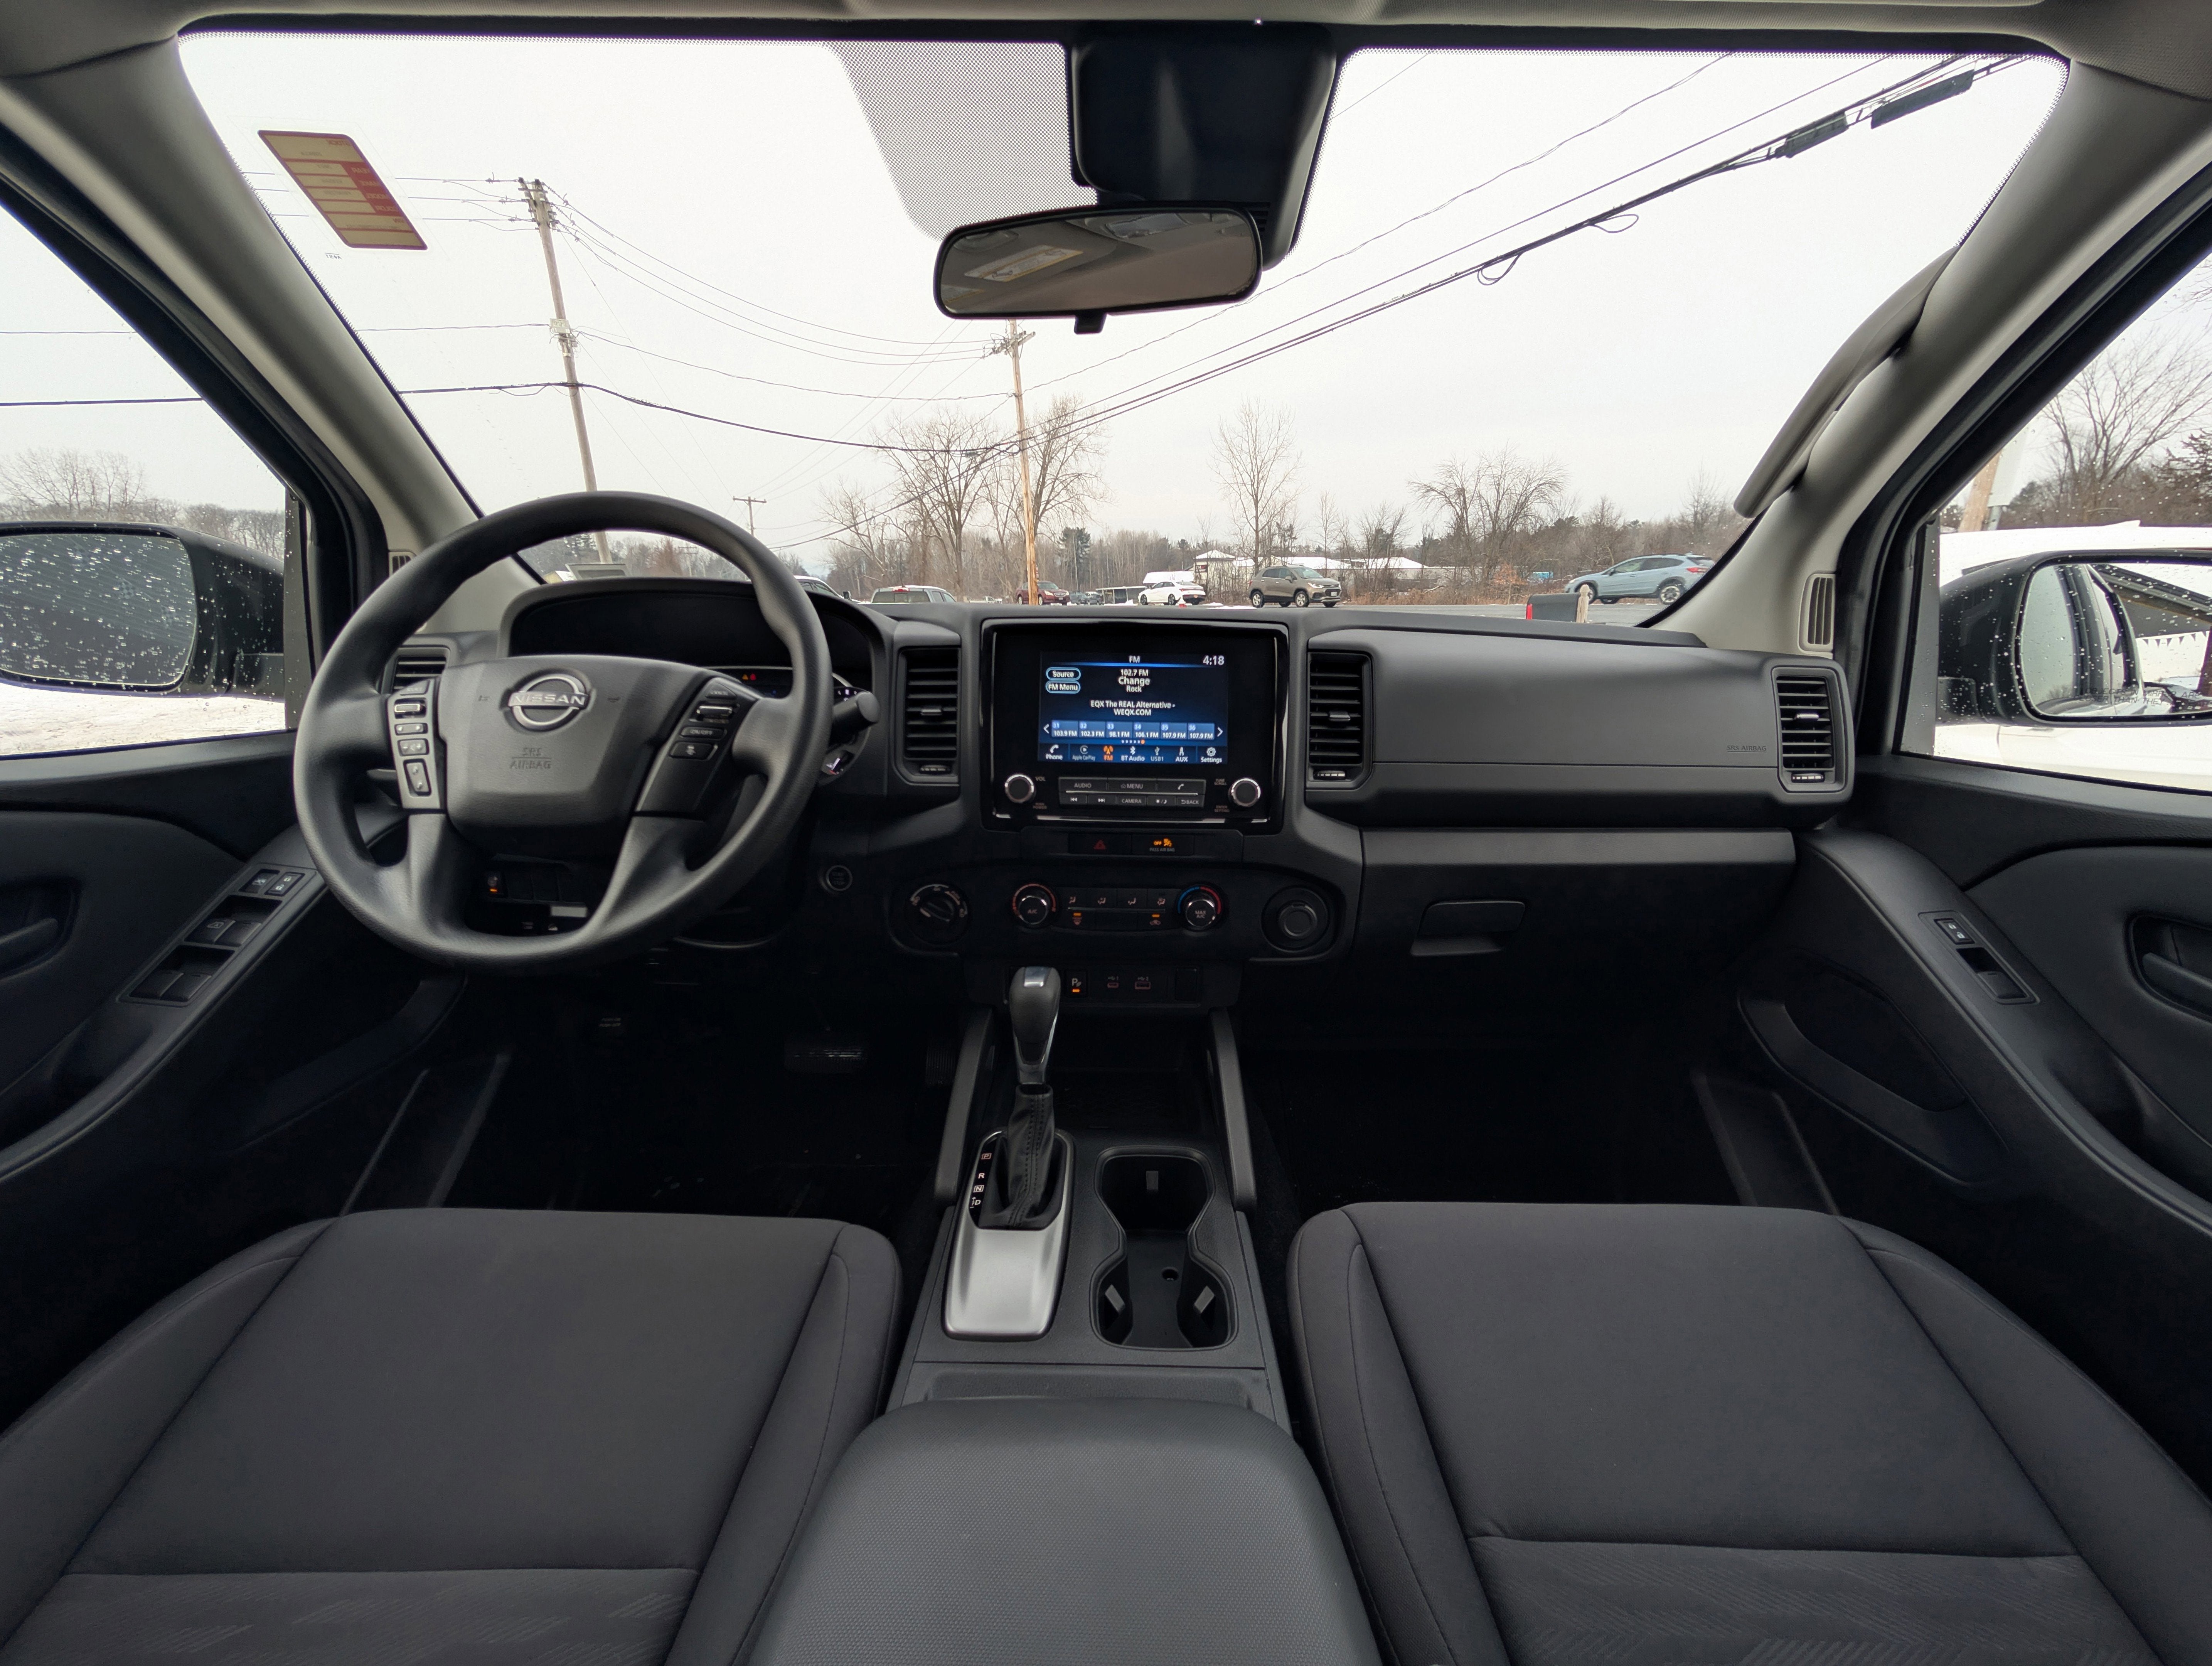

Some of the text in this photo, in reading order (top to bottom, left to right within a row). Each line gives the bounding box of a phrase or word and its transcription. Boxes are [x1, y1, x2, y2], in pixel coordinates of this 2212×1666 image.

[1203, 655, 1225, 665] 4:18
[1118, 676, 1150, 687] Change
[512, 694, 586, 706] NISSAN
[1090, 700, 1104, 708] EQX
[522, 747, 542, 757] SRS
[509, 760, 552, 769] AIRBAG
[1200, 756, 1222, 764] Settings
